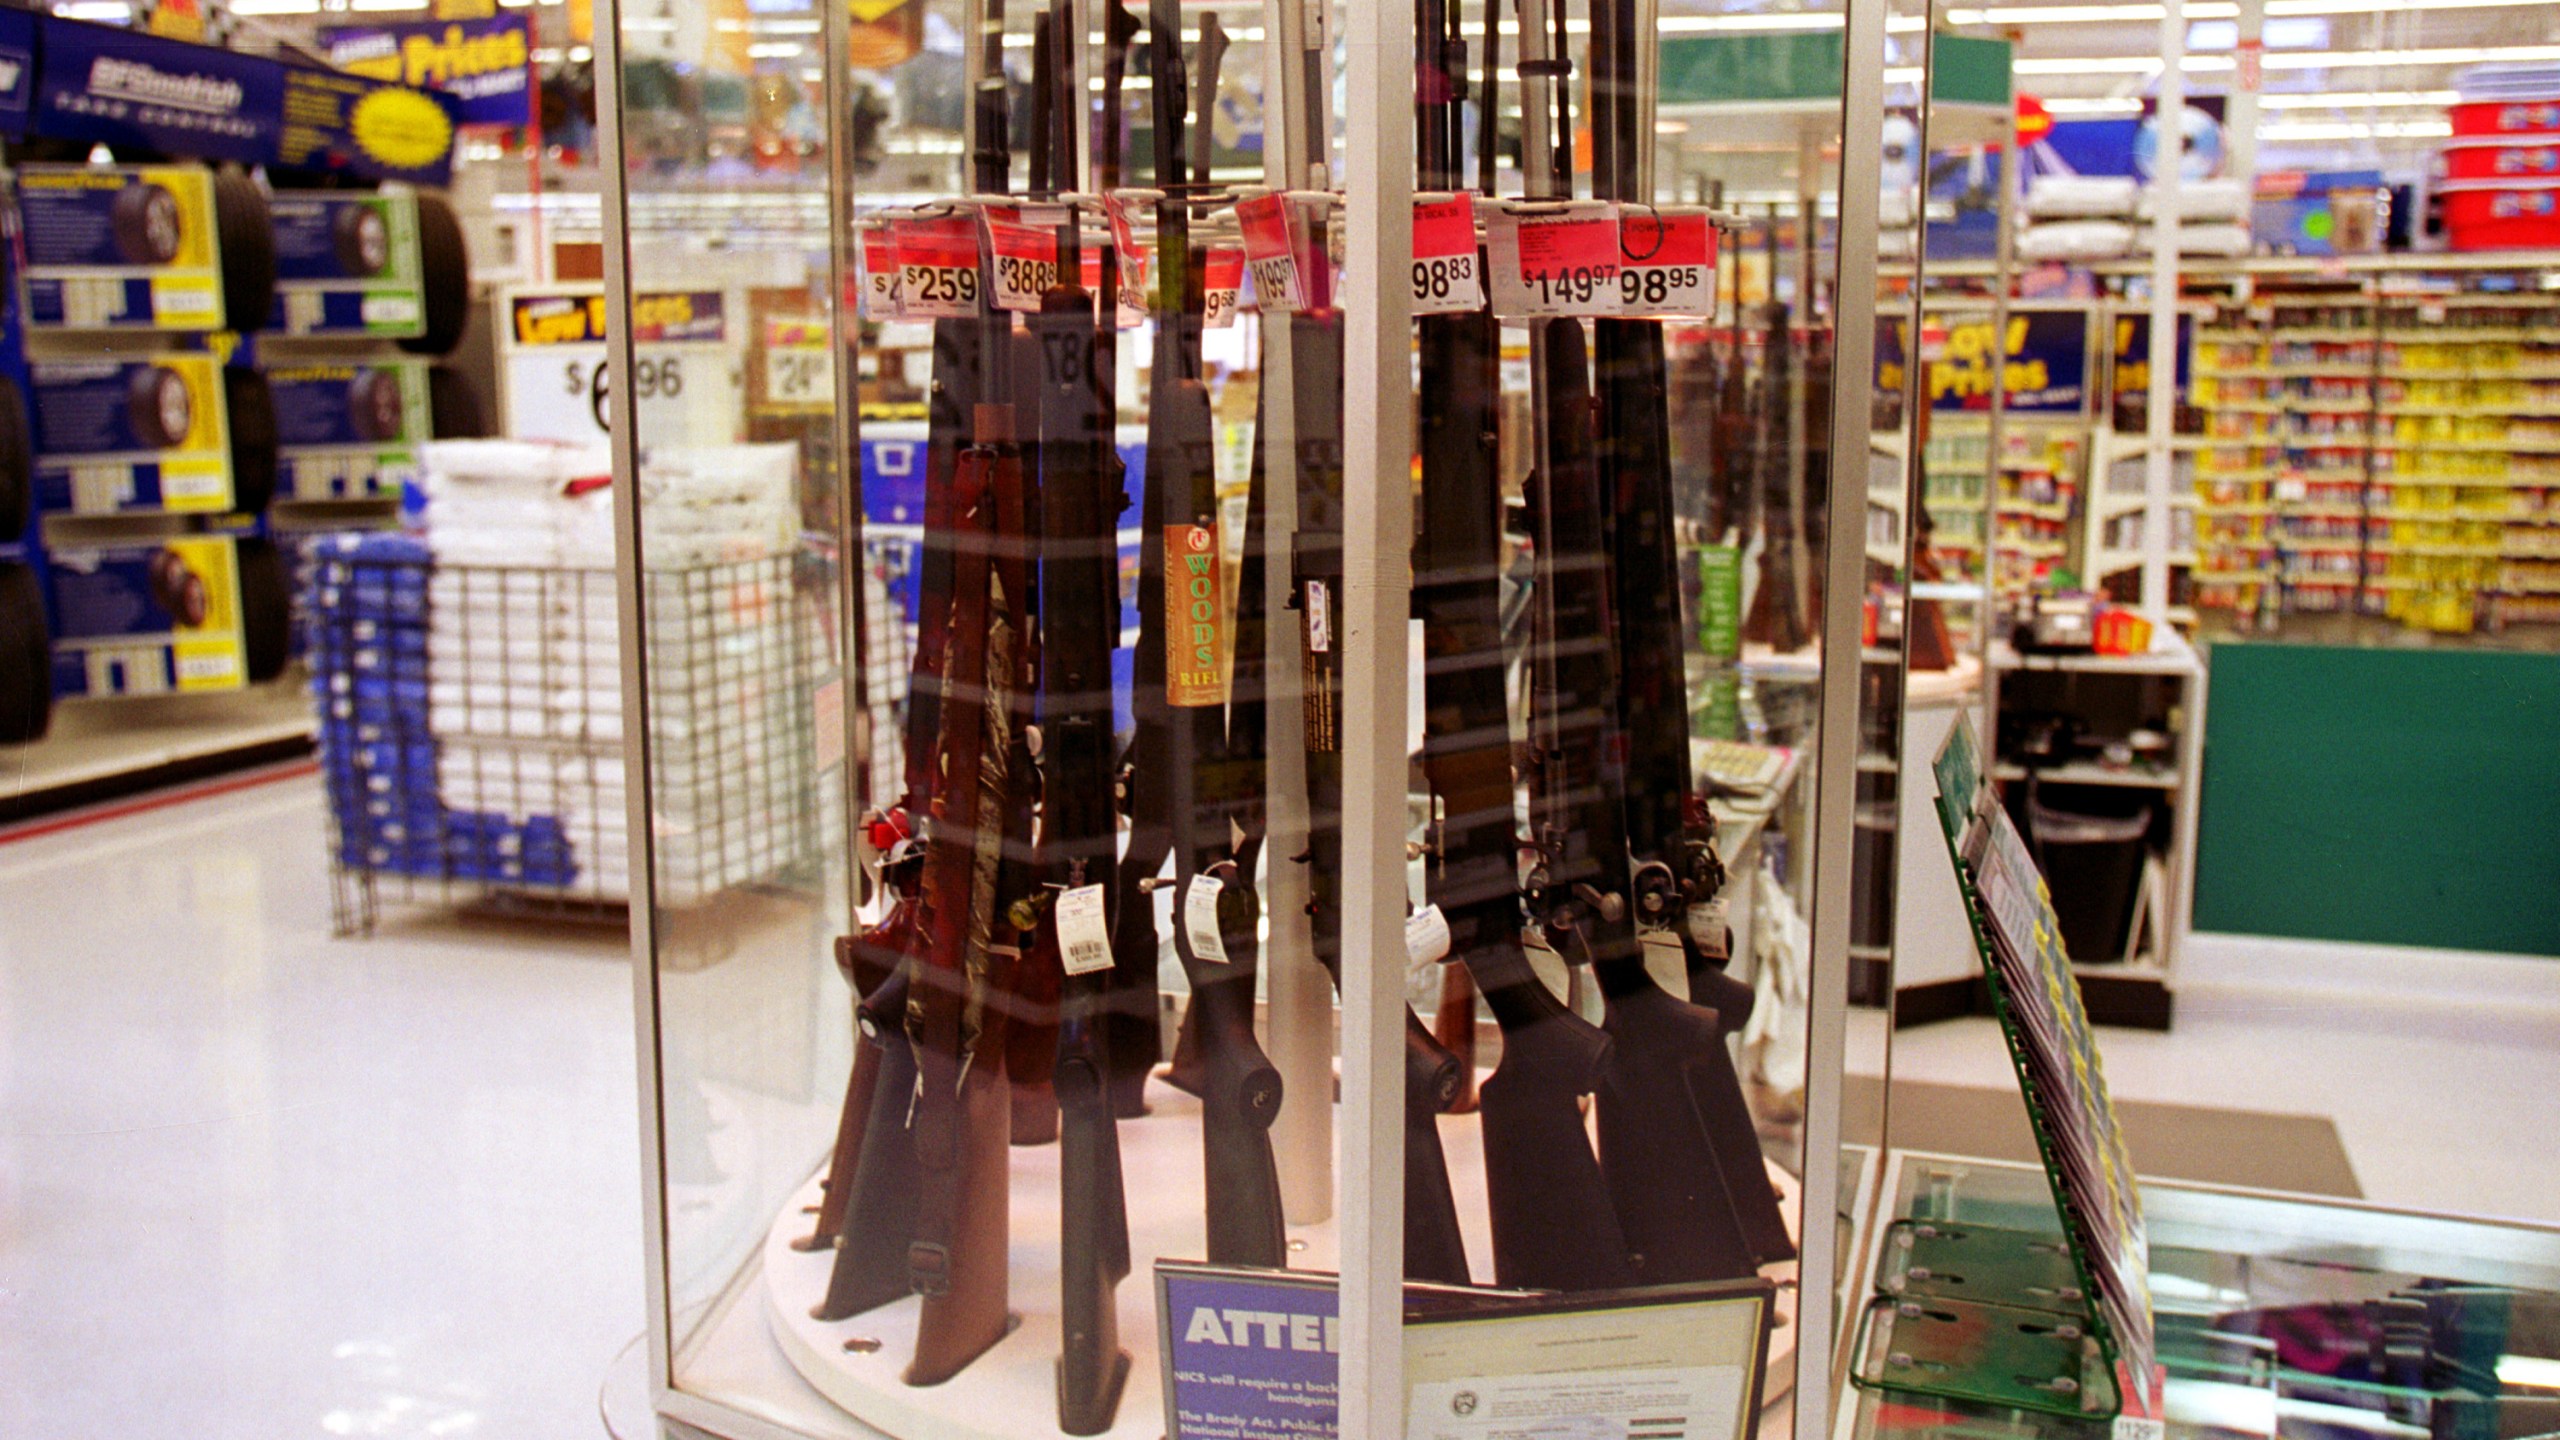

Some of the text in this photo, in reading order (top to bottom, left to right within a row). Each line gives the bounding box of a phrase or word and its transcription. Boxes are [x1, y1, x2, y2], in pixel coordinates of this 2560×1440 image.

[906, 267, 976, 302] $259
[1184, 553, 1214, 669] WOODS
[1174, 1370, 1206, 1384] NICS
[1209, 1374, 1235, 1386] will
[1239, 1377, 1289, 1391] require
[1178, 1409, 1203, 1422] The
[1206, 1412, 1247, 1428] Brady
[1280, 1417, 1323, 1432] Public
[1179, 1423, 1240, 1438] National
